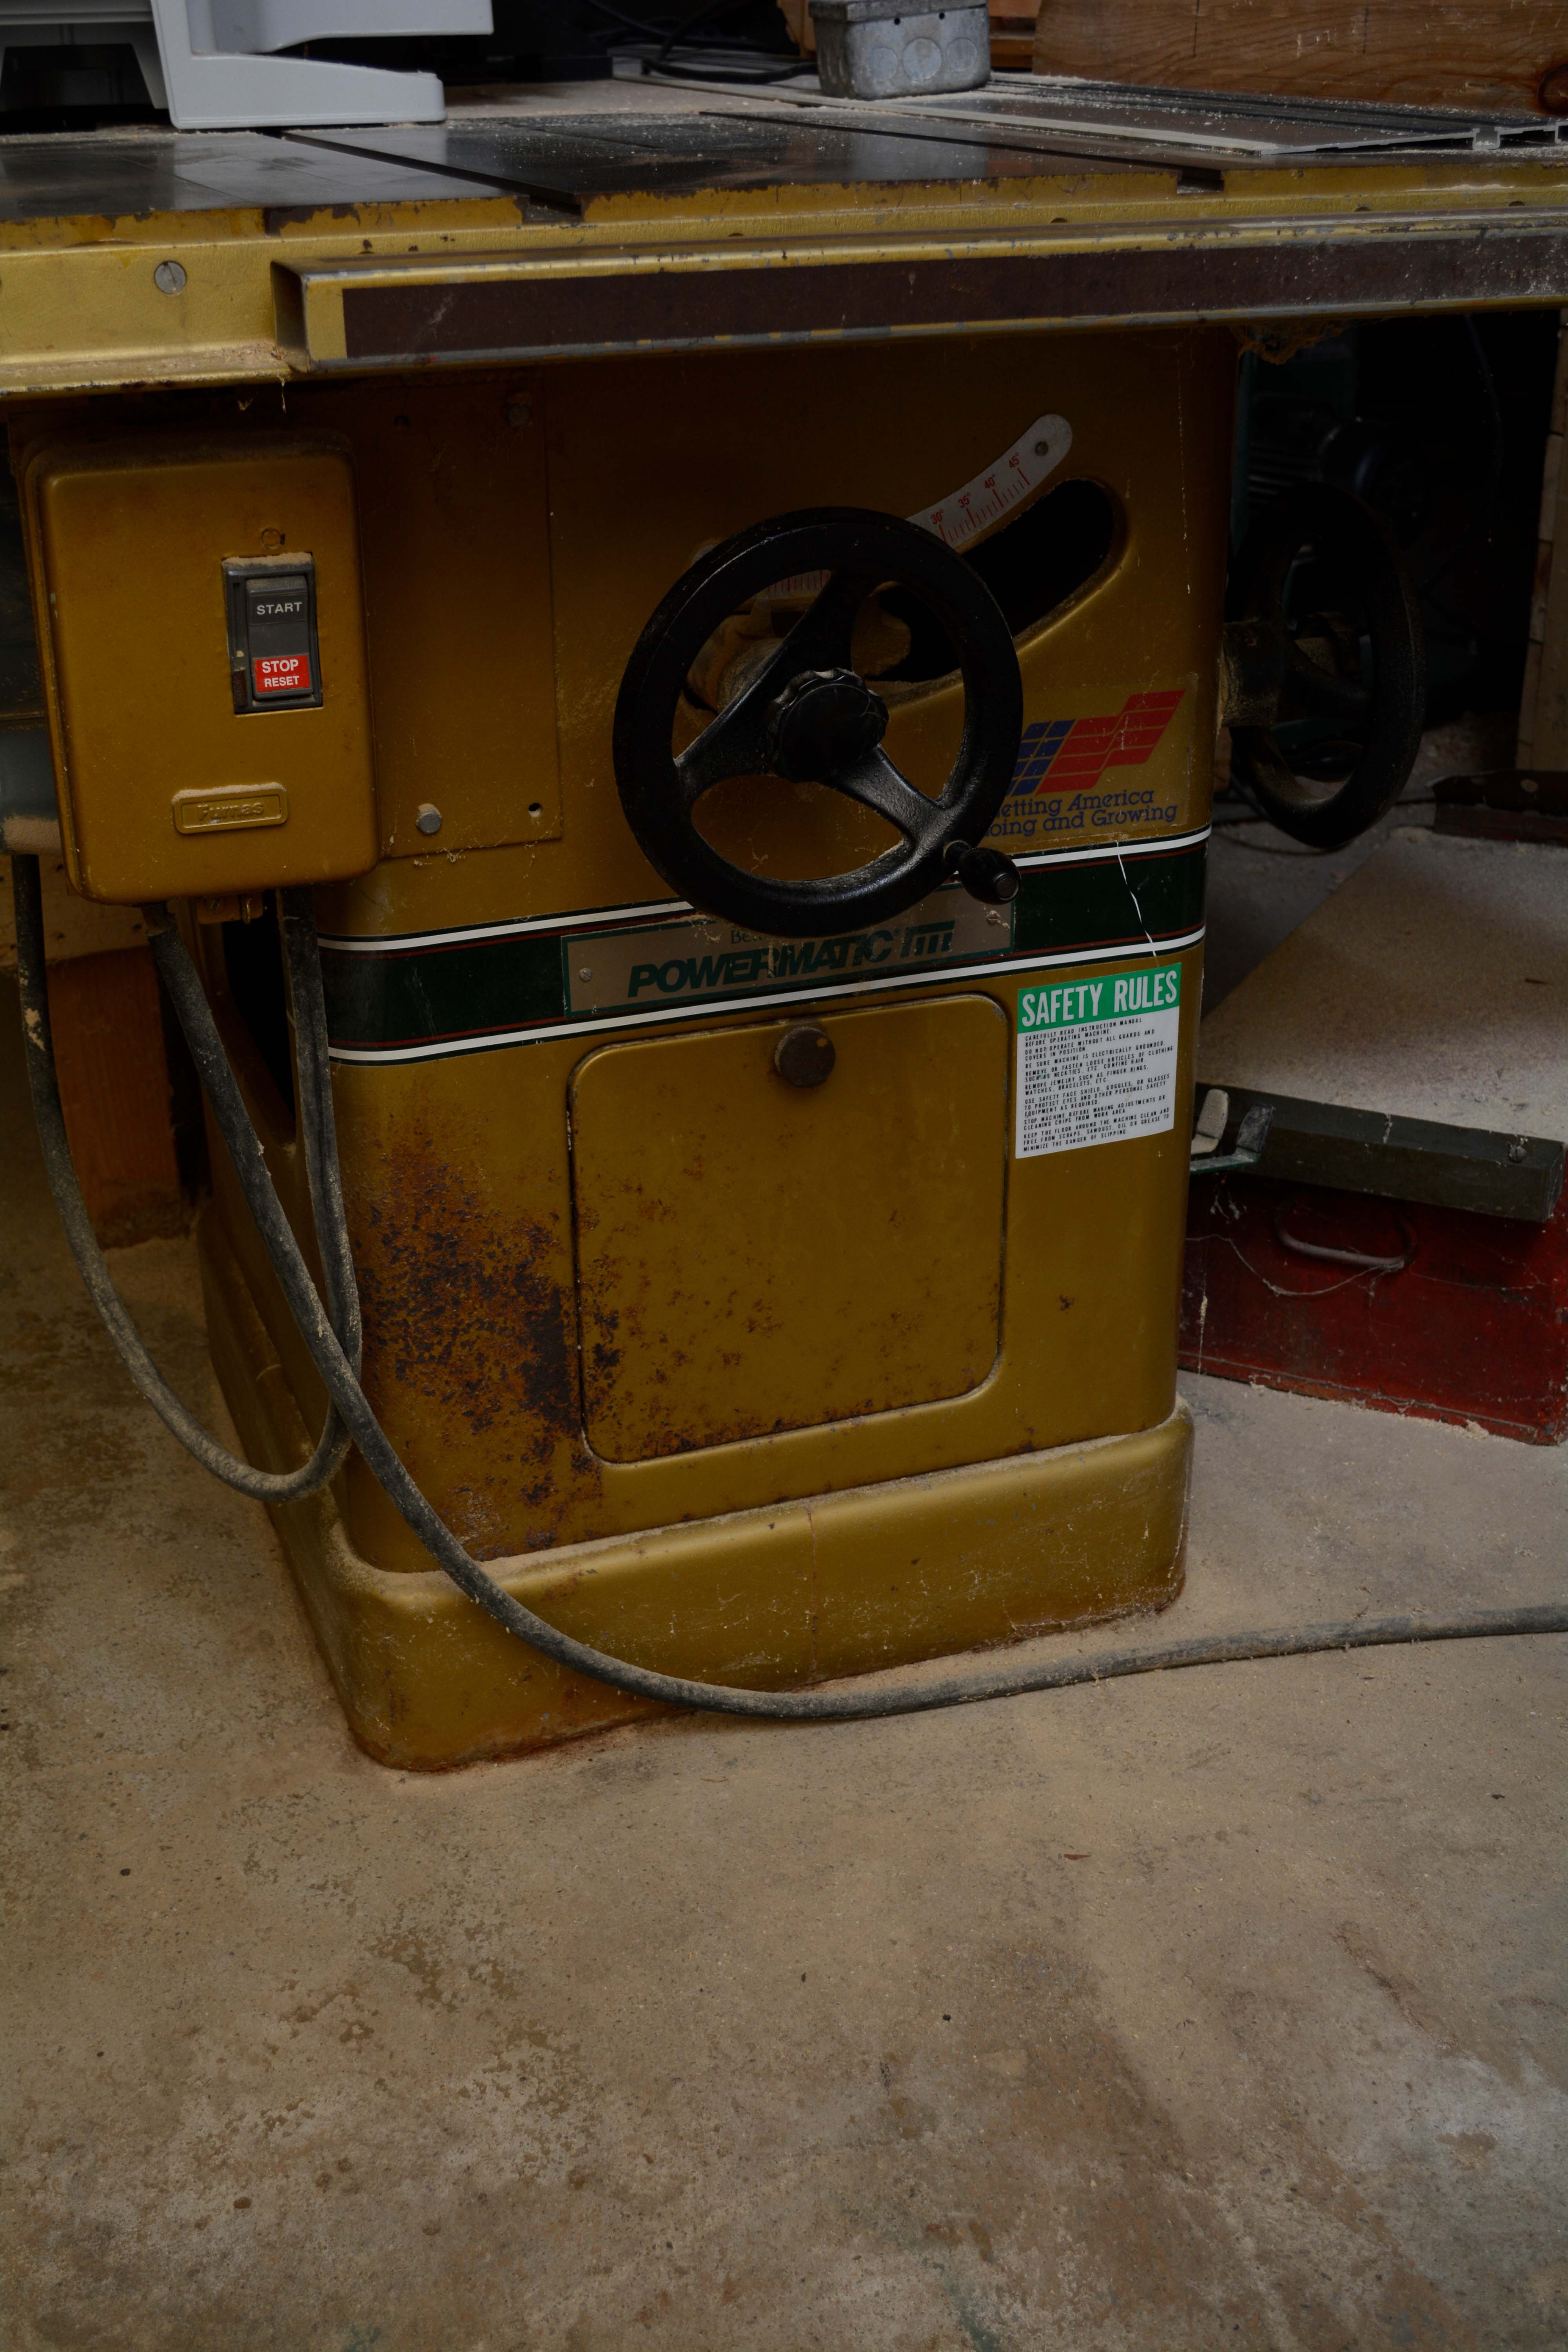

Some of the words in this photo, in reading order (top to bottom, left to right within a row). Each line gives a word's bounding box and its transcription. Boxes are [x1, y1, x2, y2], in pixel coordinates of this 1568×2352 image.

[257, 602, 302, 615] START
[262, 659, 299, 673] STOP
[264, 675, 300, 687] RESET
[997, 799, 1062, 818] etting
[1067, 790, 1154, 812] America
[985, 819, 1037, 837] oing
[1043, 812, 1084, 831] and
[1092, 804, 1178, 825] Growing
[1022, 983, 1104, 1027] SAFETY
[1114, 970, 1177, 1013] RULES
[1025, 1032, 1056, 1041] CAREFULLY
[1079, 1022, 1116, 1032] INSTRUCTION
[1050, 1034, 1080, 1043] OPERATING
[1050, 1042, 1073, 1051] OPERATE
[1078, 1038, 1102, 1046] WITHOUT
[1093, 1047, 1131, 1057] ELECTRICALLY
[1108, 1054, 1134, 1062] ARTICLES
[1149, 1046, 1172, 1055] CLOTHING
[1104, 1060, 1127, 1069] CONFINE
[1051, 1077, 1074, 1086] JEWELRY
[1148, 1074, 1169, 1083] GLASSES
[1035, 1100, 1058, 1109] PROTECT
[1116, 1086, 1142, 1094] PERSONAL
[1147, 1081, 1165, 1089] SAFETY
[1118, 1098, 1155, 1108] ADJUSTMENTS
[1025, 1107, 1056, 1116] EQUIPMENT
[1024, 1122, 1051, 1130] CLEANING
[1024, 1143, 1048, 1151] MINIMIZE
